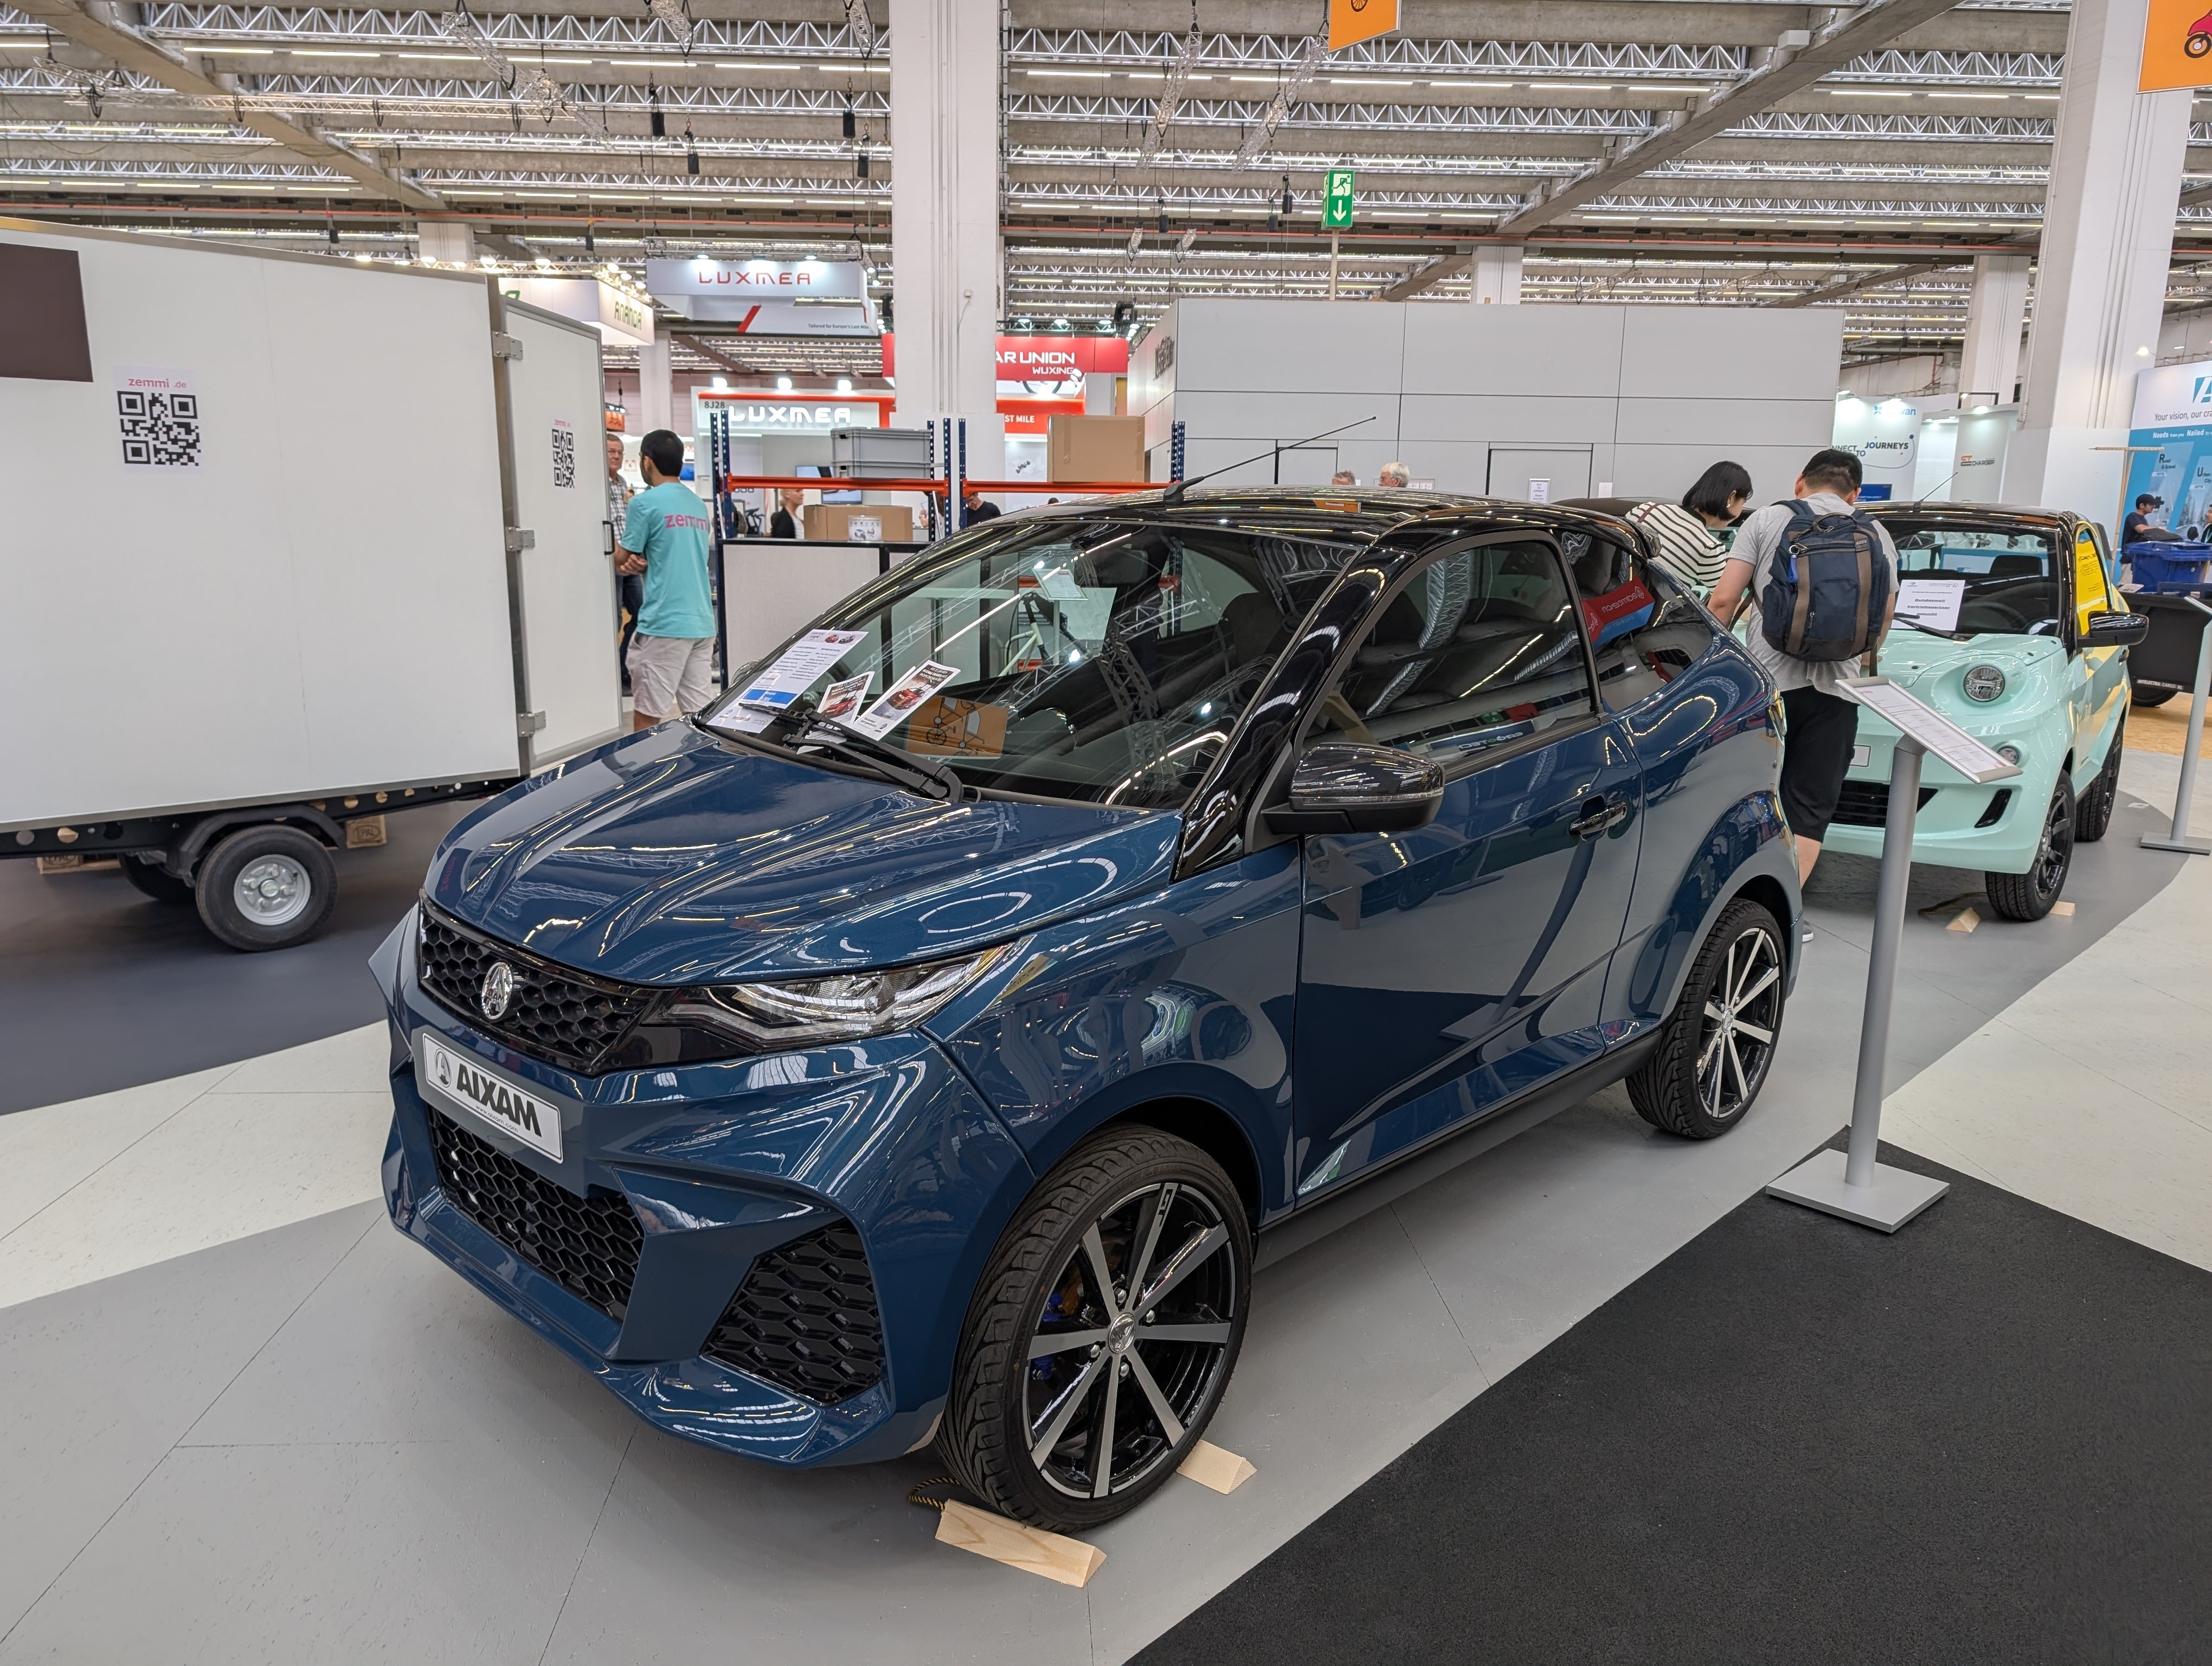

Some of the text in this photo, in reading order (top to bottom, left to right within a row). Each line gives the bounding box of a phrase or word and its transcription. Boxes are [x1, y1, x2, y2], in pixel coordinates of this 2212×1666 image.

[699, 271, 811, 285] LUXMEA
[1019, 351, 1075, 364] UNION
[128, 379, 169, 388] zemmi
[728, 406, 851, 423] LUXMEA
[1016, 414, 1035, 423] MILE
[2170, 412, 2189, 420] vision,
[1864, 441, 1909, 450] JOURNEYS
[456, 1062, 542, 1138] AIXAM
[475, 1104, 518, 1133] www.aixam.com
